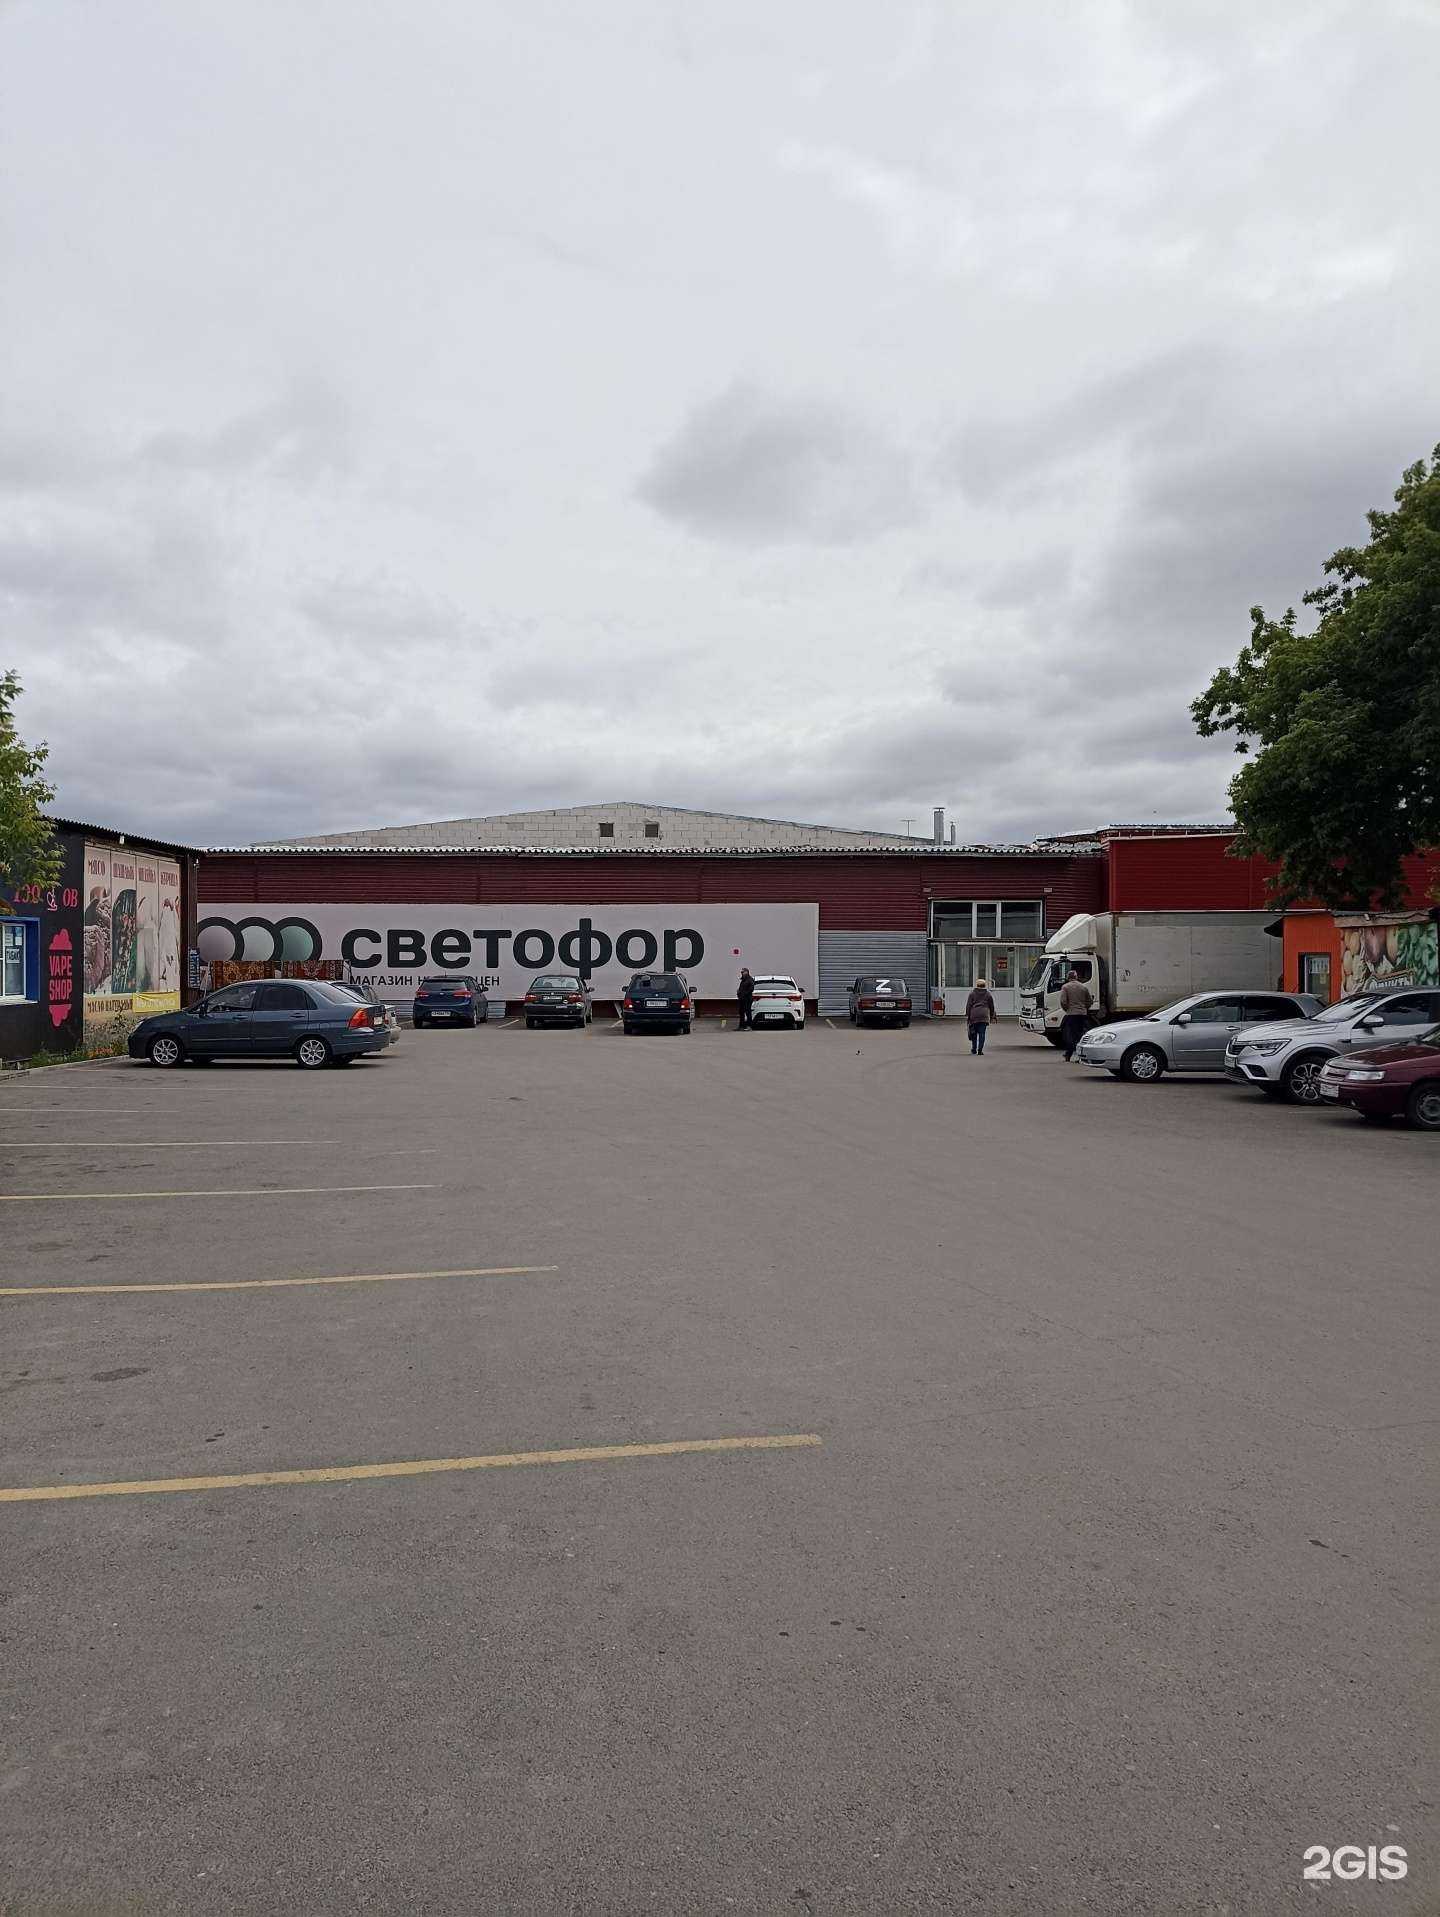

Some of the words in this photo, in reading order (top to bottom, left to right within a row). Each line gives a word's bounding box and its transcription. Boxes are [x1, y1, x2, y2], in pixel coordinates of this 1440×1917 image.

[49, 955, 73, 976] VAPE
[49, 979, 73, 1001] SHOP
[350, 975, 413, 986] МАГАЗИН
